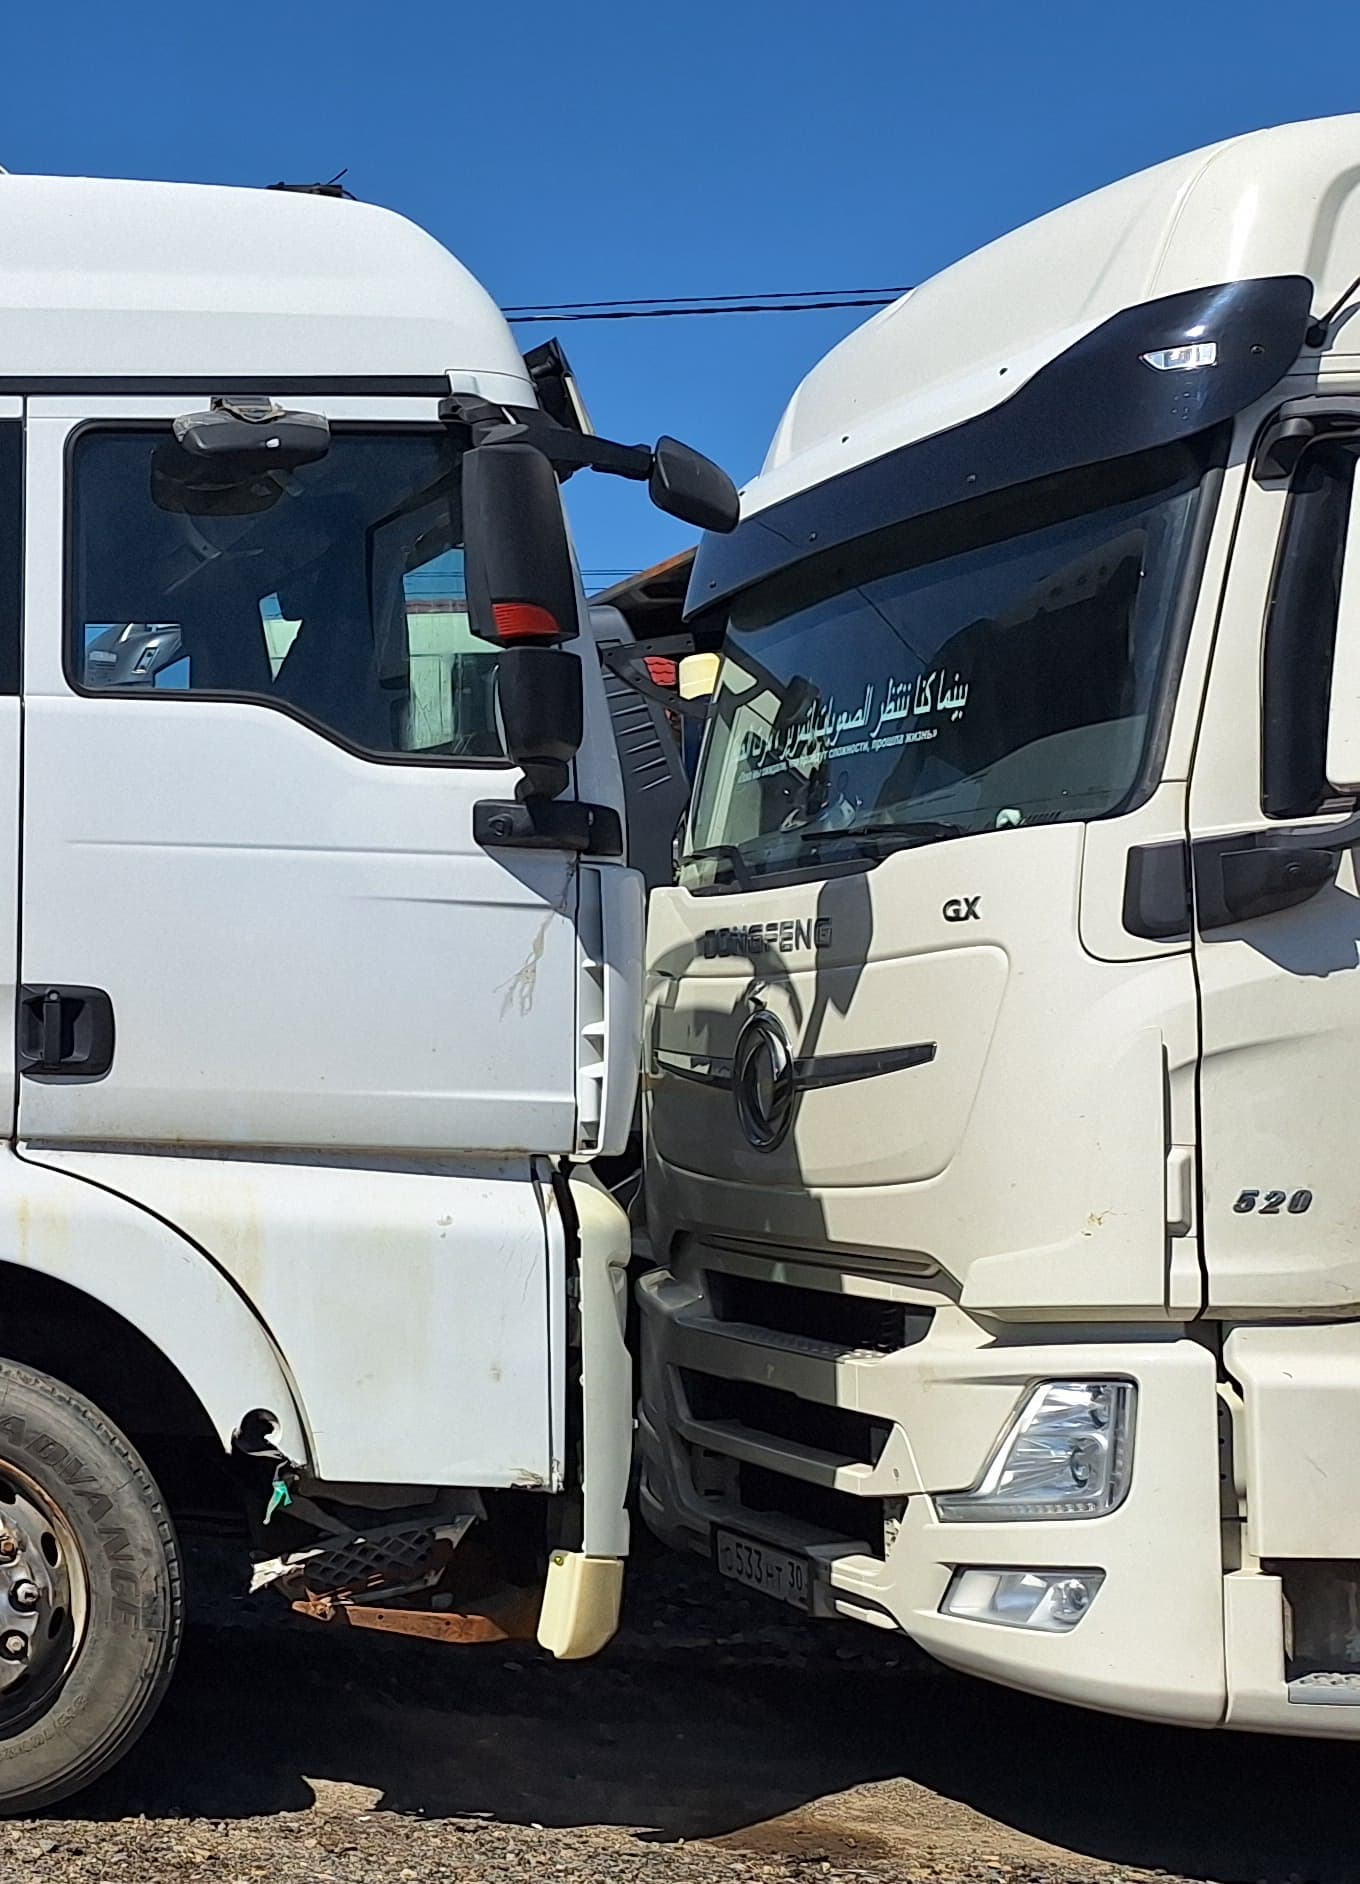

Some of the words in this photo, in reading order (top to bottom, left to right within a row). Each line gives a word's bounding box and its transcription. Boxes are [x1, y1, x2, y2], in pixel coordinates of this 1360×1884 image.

[942, 896, 981, 922] GX
[703, 917, 832, 959] DONGFENG
[1232, 1189, 1313, 1214] 520
